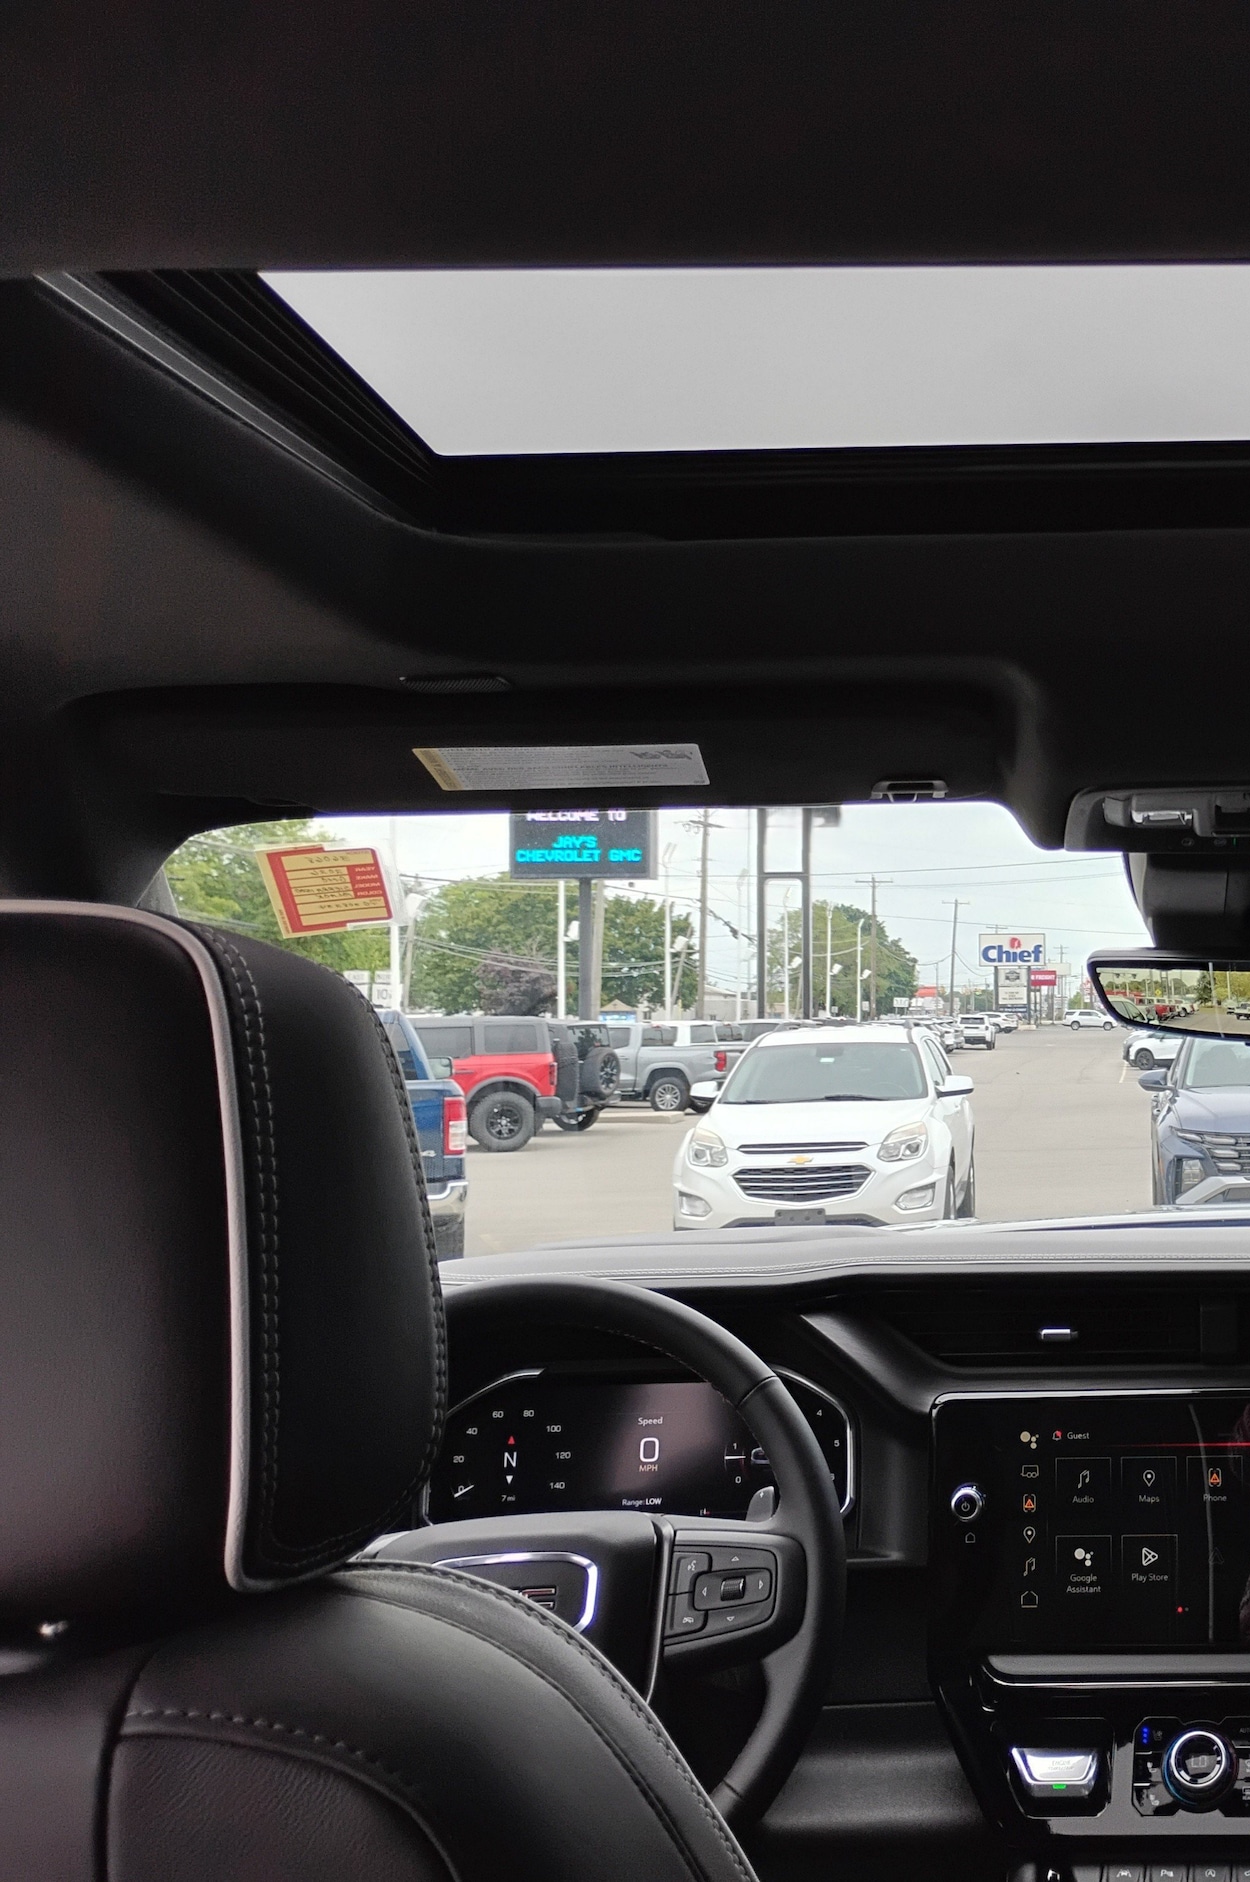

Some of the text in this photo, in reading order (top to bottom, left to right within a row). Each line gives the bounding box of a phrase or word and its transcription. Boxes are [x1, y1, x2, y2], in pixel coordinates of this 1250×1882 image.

[526, 809, 626, 821] WELCOME TO
[553, 836, 598, 848] JAY'S
[516, 849, 642, 862] CHEVROLET GMC
[982, 945, 1042, 962] Chief
[492, 1410, 504, 1418] 60
[523, 1410, 534, 1418] 80
[638, 1416, 663, 1426] Speed
[466, 1427, 478, 1435] 40
[1066, 1432, 1090, 1440] Guest
[639, 1437, 660, 1462] 0
[453, 1455, 464, 1464] 20
[504, 1452, 518, 1468] N
[555, 1451, 571, 1460] 120
[638, 1464, 658, 1472] MPH
[735, 1476, 742, 1484] 0
[550, 1482, 566, 1490] 140
[1072, 1495, 1094, 1504] Audio
[1138, 1495, 1160, 1504] Maps
[1203, 1494, 1227, 1502] Phone
[1070, 1574, 1098, 1584] Google
[1131, 1572, 1168, 1583] Play Store
[1066, 1585, 1101, 1594] Assistant
